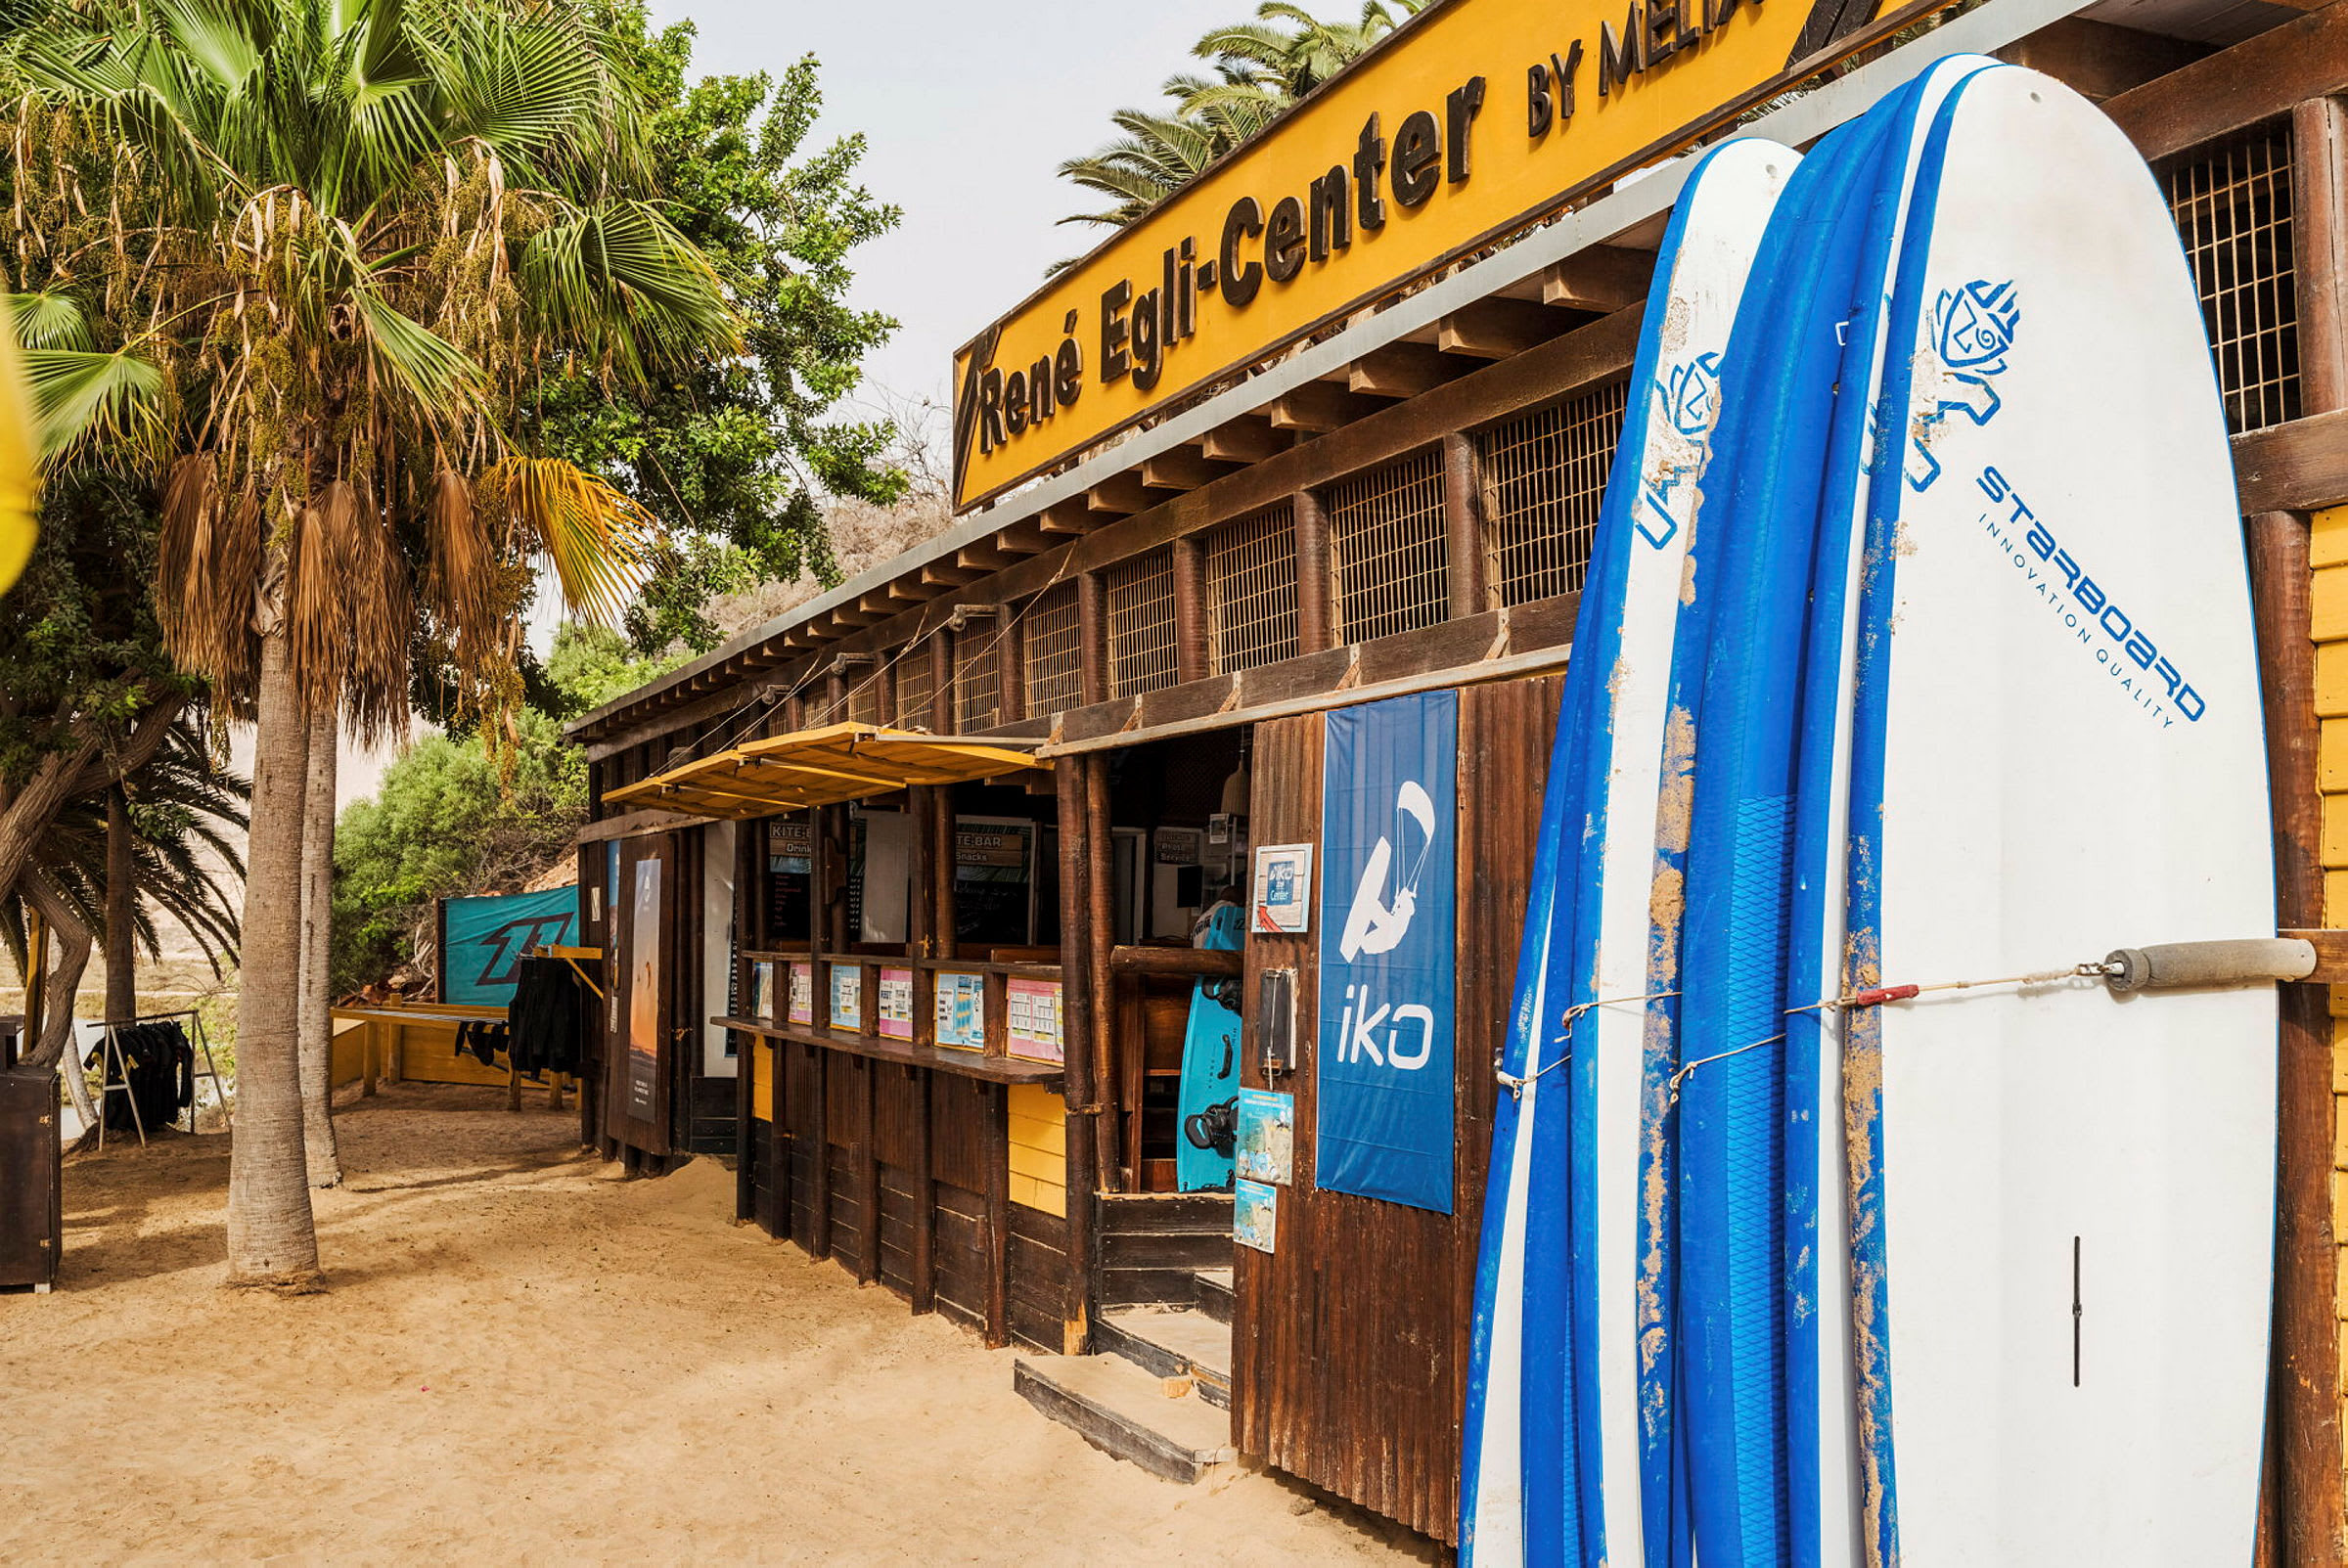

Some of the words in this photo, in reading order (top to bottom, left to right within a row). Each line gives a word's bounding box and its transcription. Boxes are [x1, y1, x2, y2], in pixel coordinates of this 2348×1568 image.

[979, 308, 1083, 454] René
[1100, 76, 1486, 390] Egli-Center
[1528, 38, 1583, 138] BY
[1978, 513, 2092, 644] INNOVATION
[2096, 649, 2174, 729] QUALITY
[1336, 985, 1434, 1070] iko
